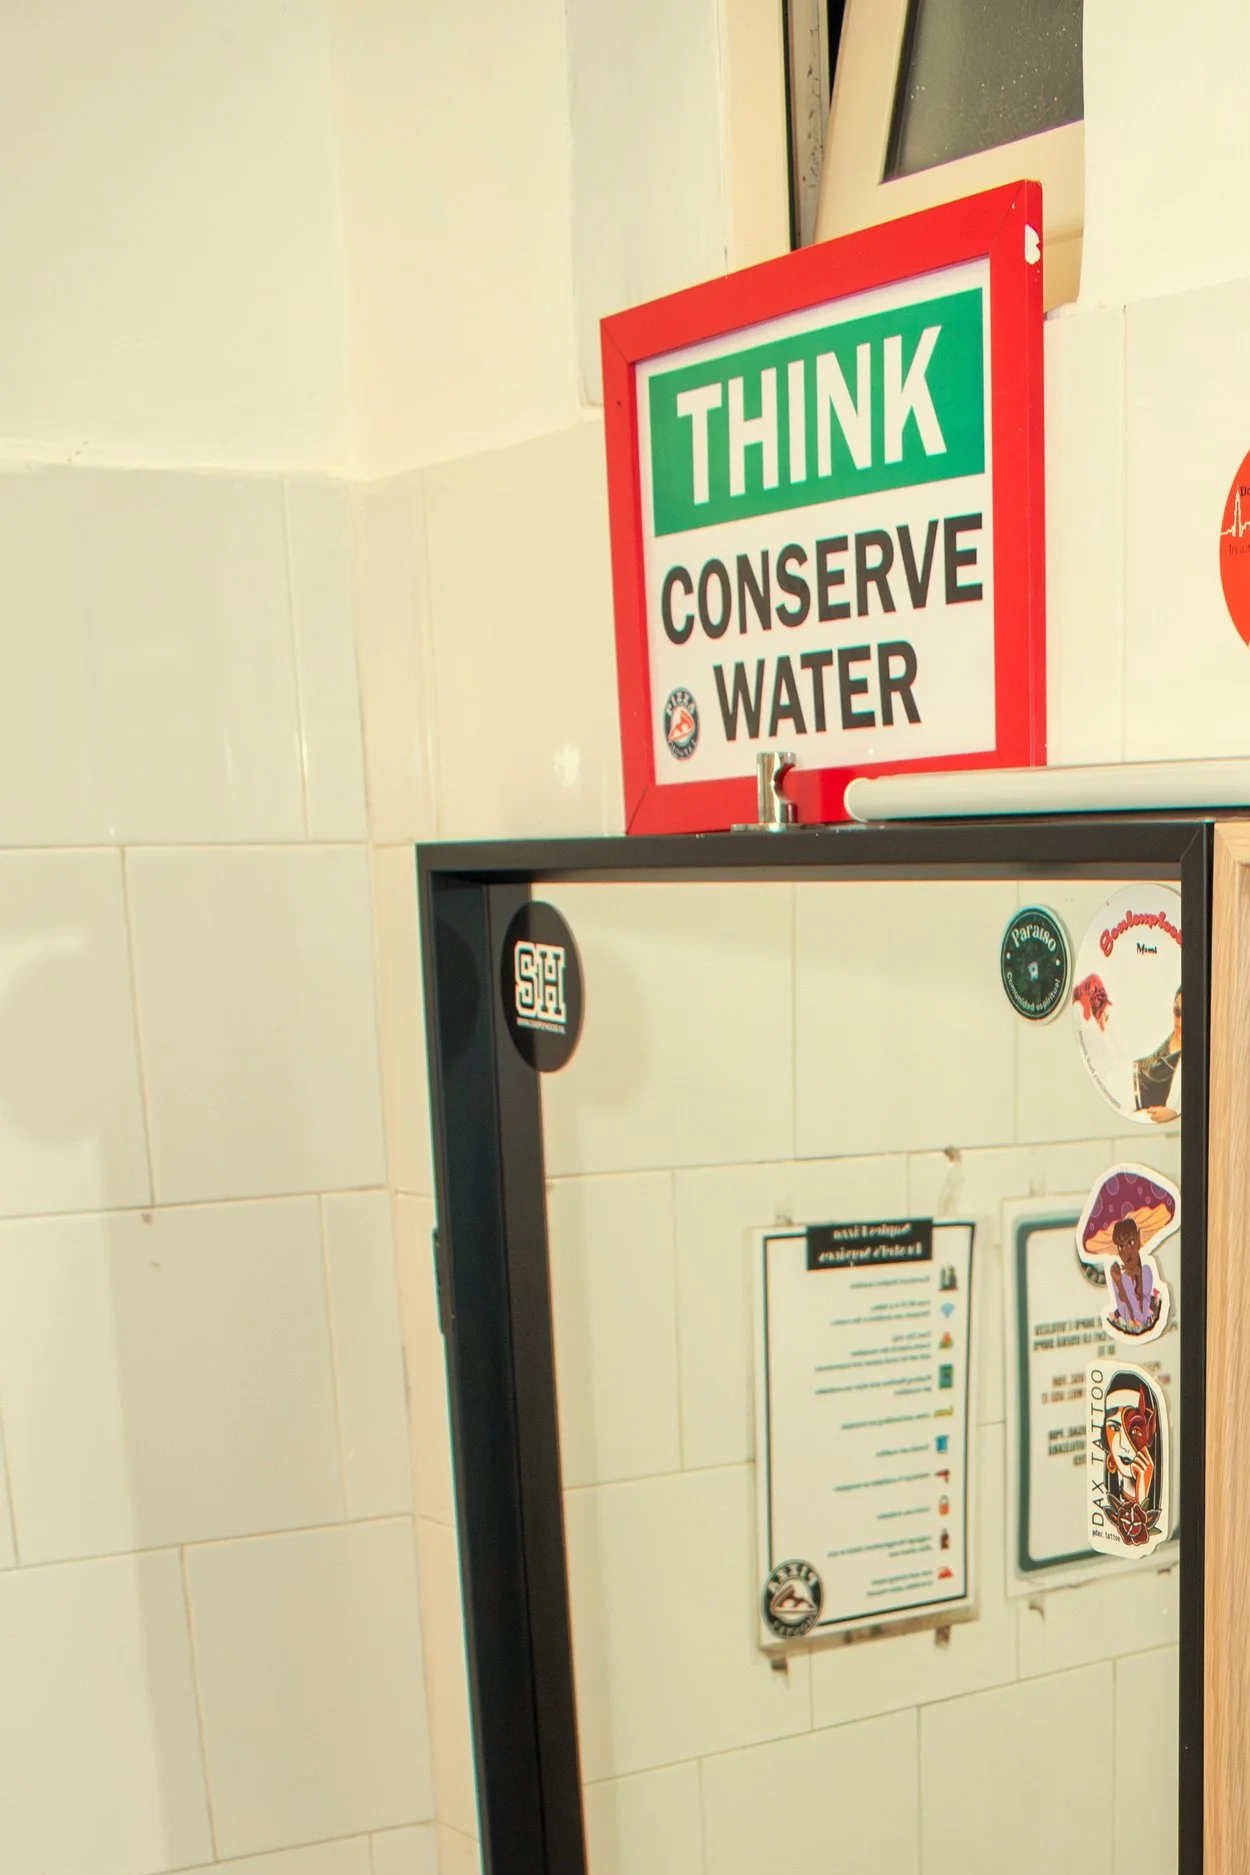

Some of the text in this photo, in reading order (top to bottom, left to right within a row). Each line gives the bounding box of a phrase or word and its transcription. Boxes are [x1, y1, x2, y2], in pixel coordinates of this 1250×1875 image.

[677, 324, 946, 506] THINK
[661, 512, 983, 646] CONSERVE
[713, 640, 922, 742] WATER
[515, 940, 566, 1024] SH
[1090, 1369, 1106, 1528] DAX TATTOO
